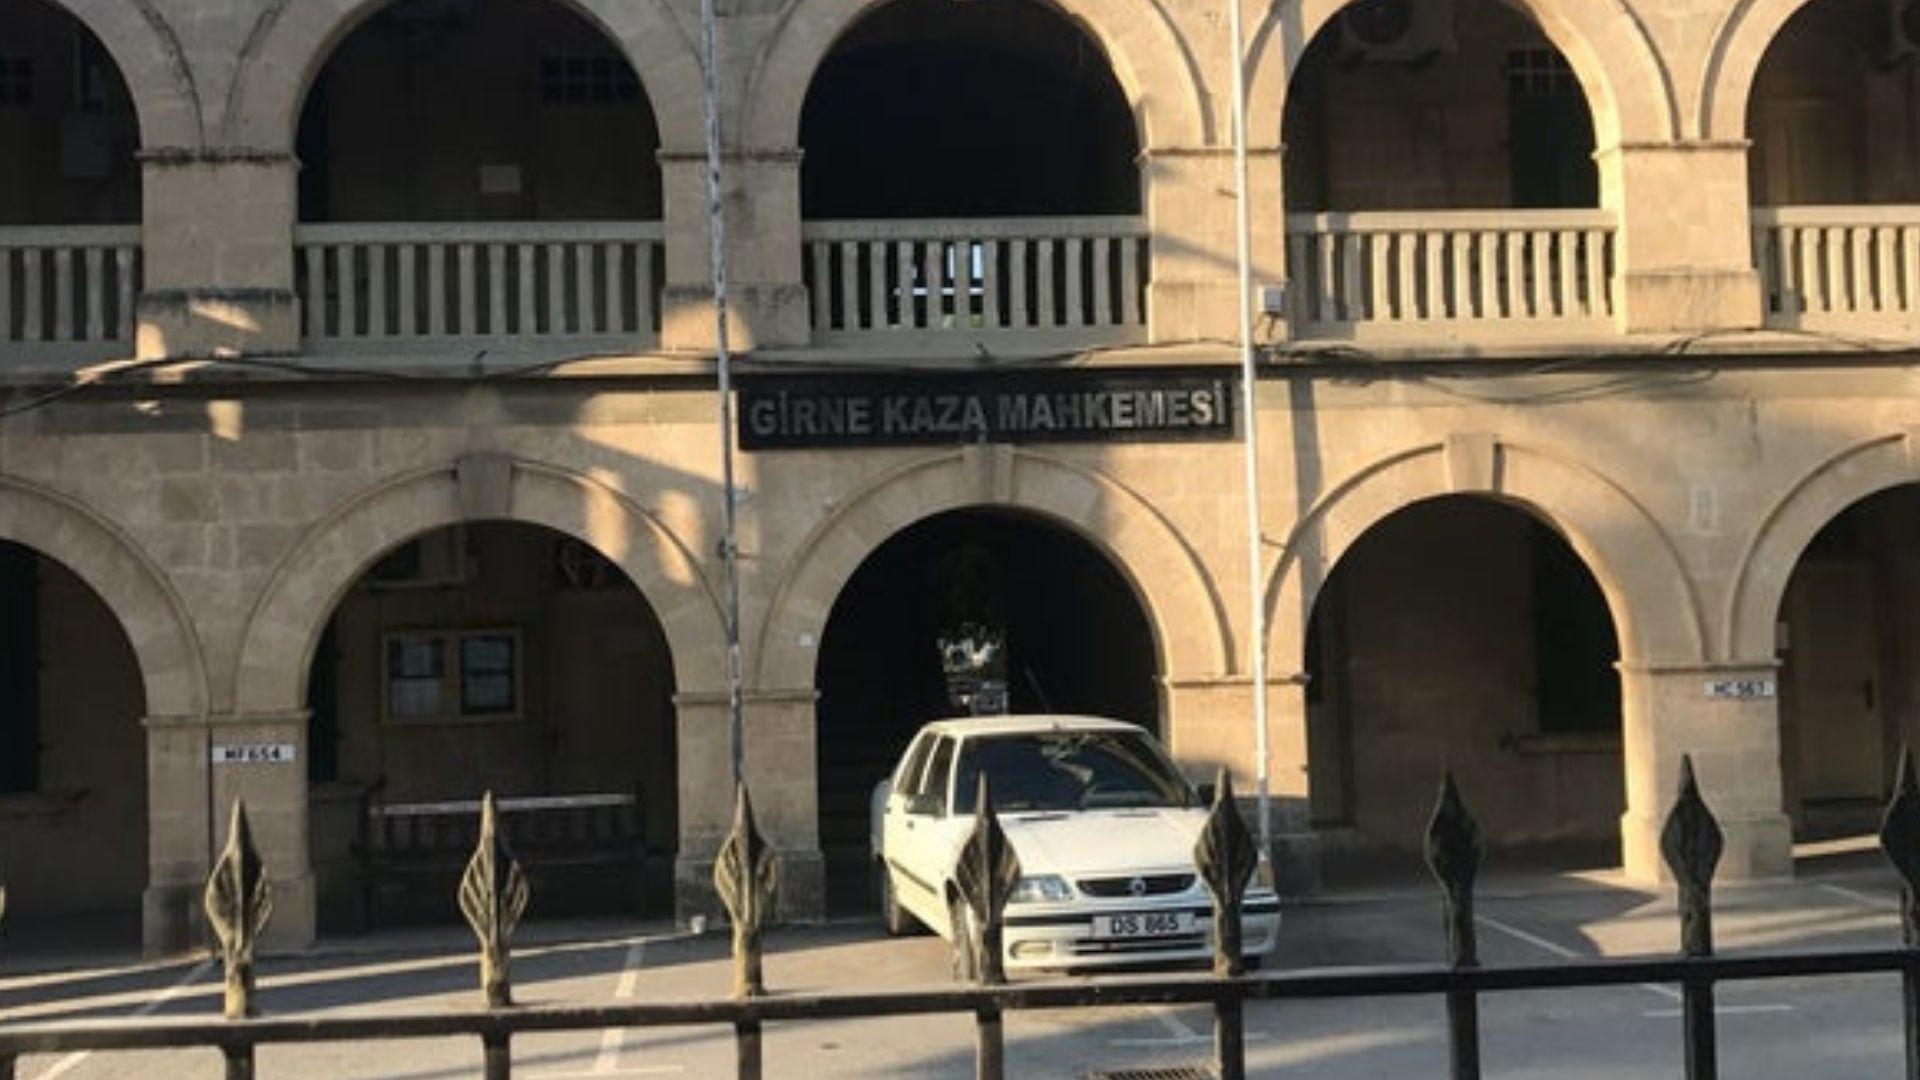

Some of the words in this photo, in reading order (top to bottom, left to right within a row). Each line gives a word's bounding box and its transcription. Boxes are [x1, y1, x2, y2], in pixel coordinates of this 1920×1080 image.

[751, 390, 871, 435] GİRNE
[884, 396, 988, 433] KAZA
[1000, 380, 1226, 430] MAHKEMESİ
[1111, 915, 1139, 934] DS
